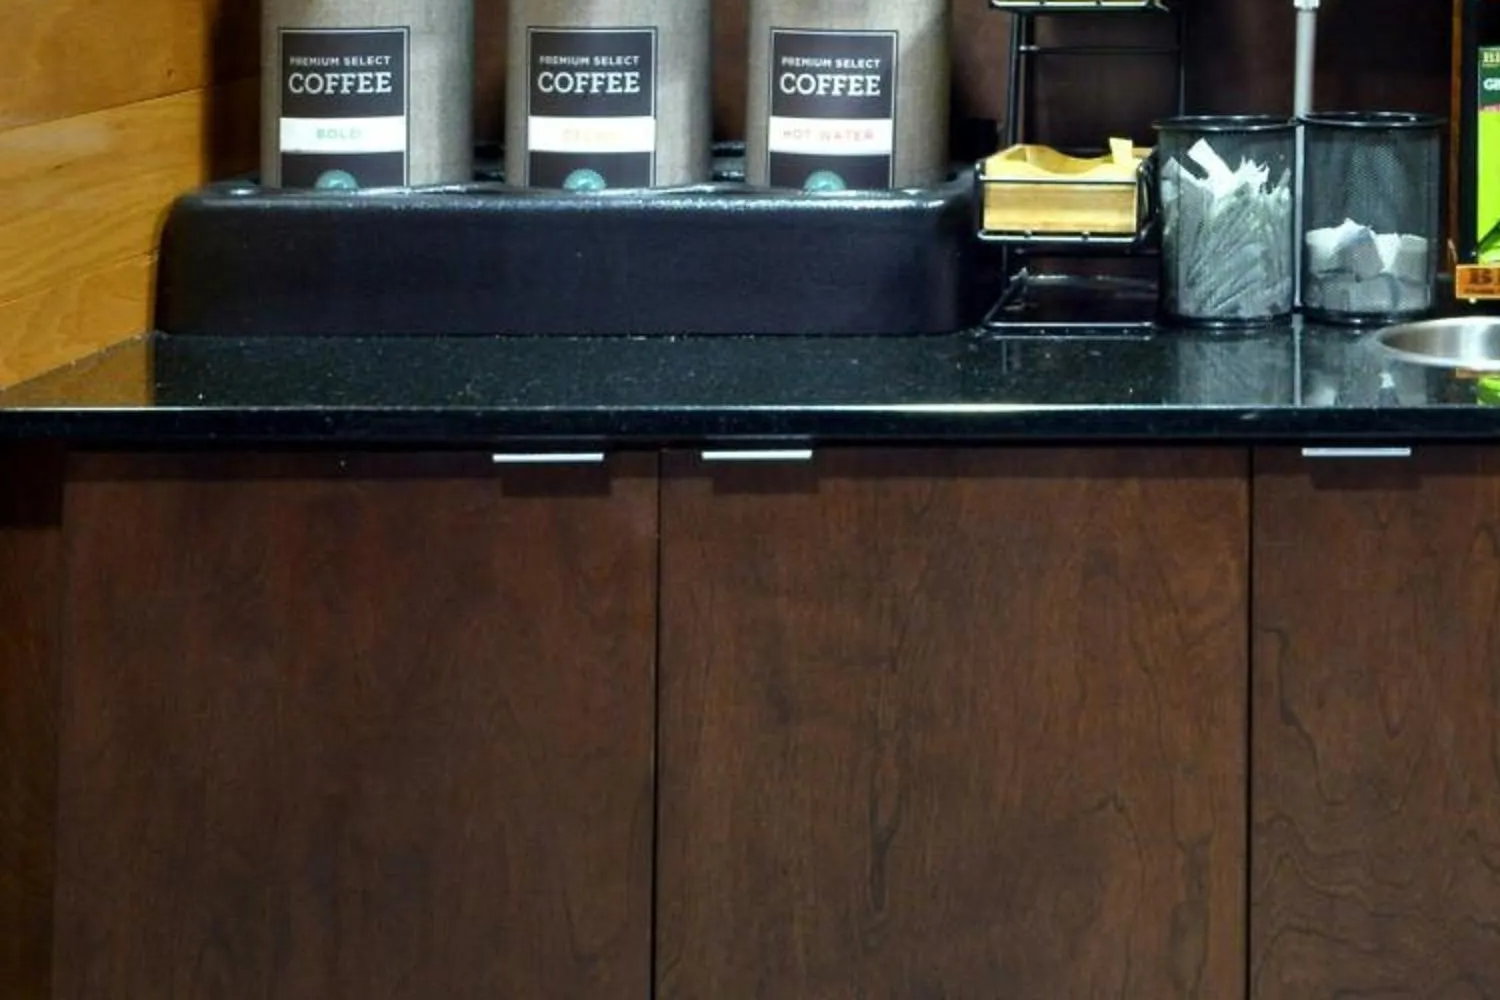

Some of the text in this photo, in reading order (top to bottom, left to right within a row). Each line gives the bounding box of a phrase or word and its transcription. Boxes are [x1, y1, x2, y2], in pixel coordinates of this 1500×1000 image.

[289, 55, 391, 66] PREMIUM SELECT
[539, 55, 640, 66] PREMIUM SELECT
[781, 56, 881, 69] PREMIUM SELECT
[288, 71, 392, 94] COFFEE
[537, 71, 641, 94] COFFEE
[779, 72, 881, 96] COFFEE
[316, 128, 362, 139] BOLD
[782, 129, 875, 141] HOT WATER
